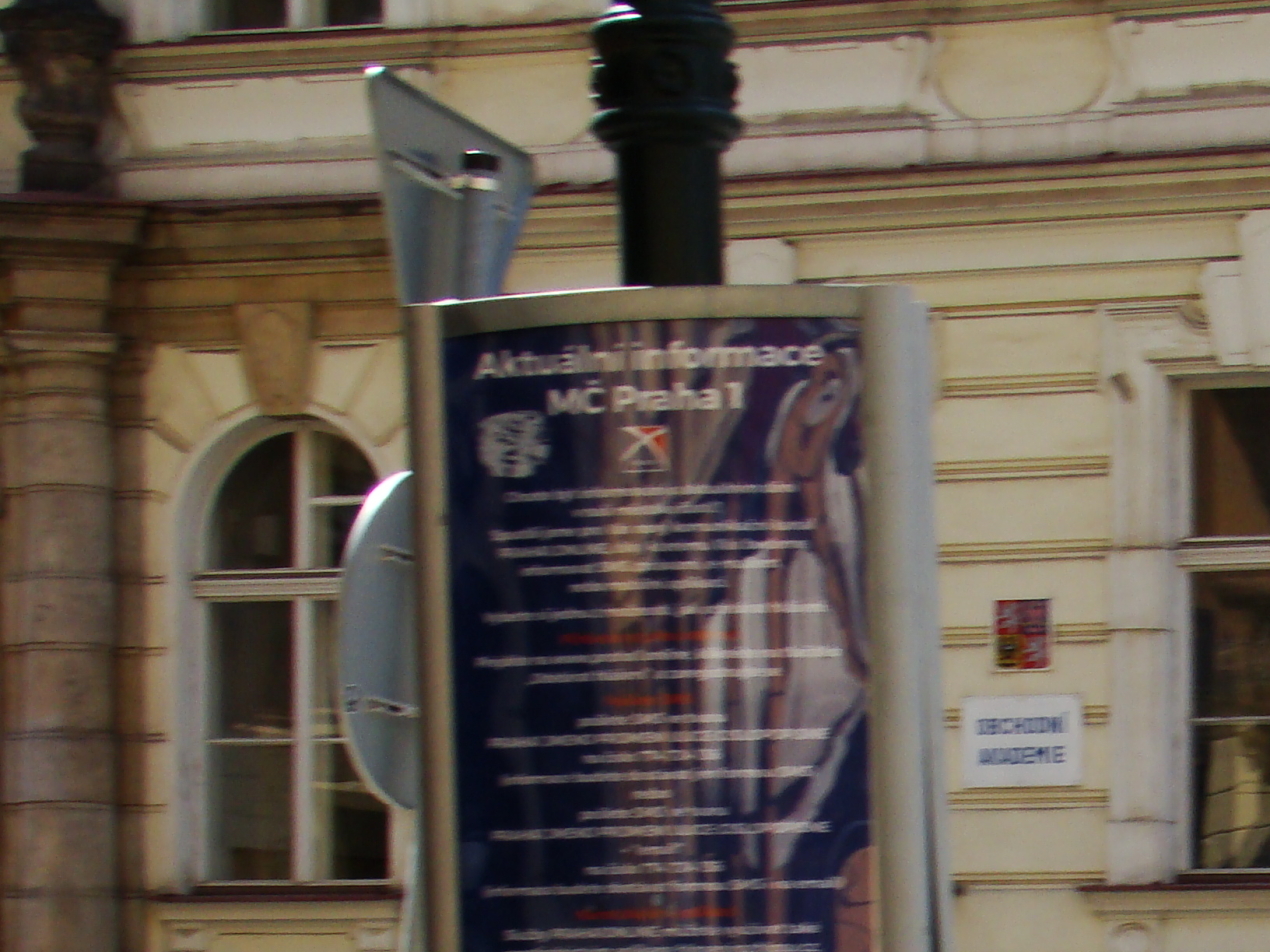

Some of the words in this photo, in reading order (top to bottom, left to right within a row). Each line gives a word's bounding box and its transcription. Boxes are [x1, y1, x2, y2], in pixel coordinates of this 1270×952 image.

[473, 341, 627, 380] Aktuální
[630, 341, 825, 372] informace
[546, 379, 606, 416] MČ
[612, 381, 720, 413] Praha
[721, 381, 746, 410] 1
